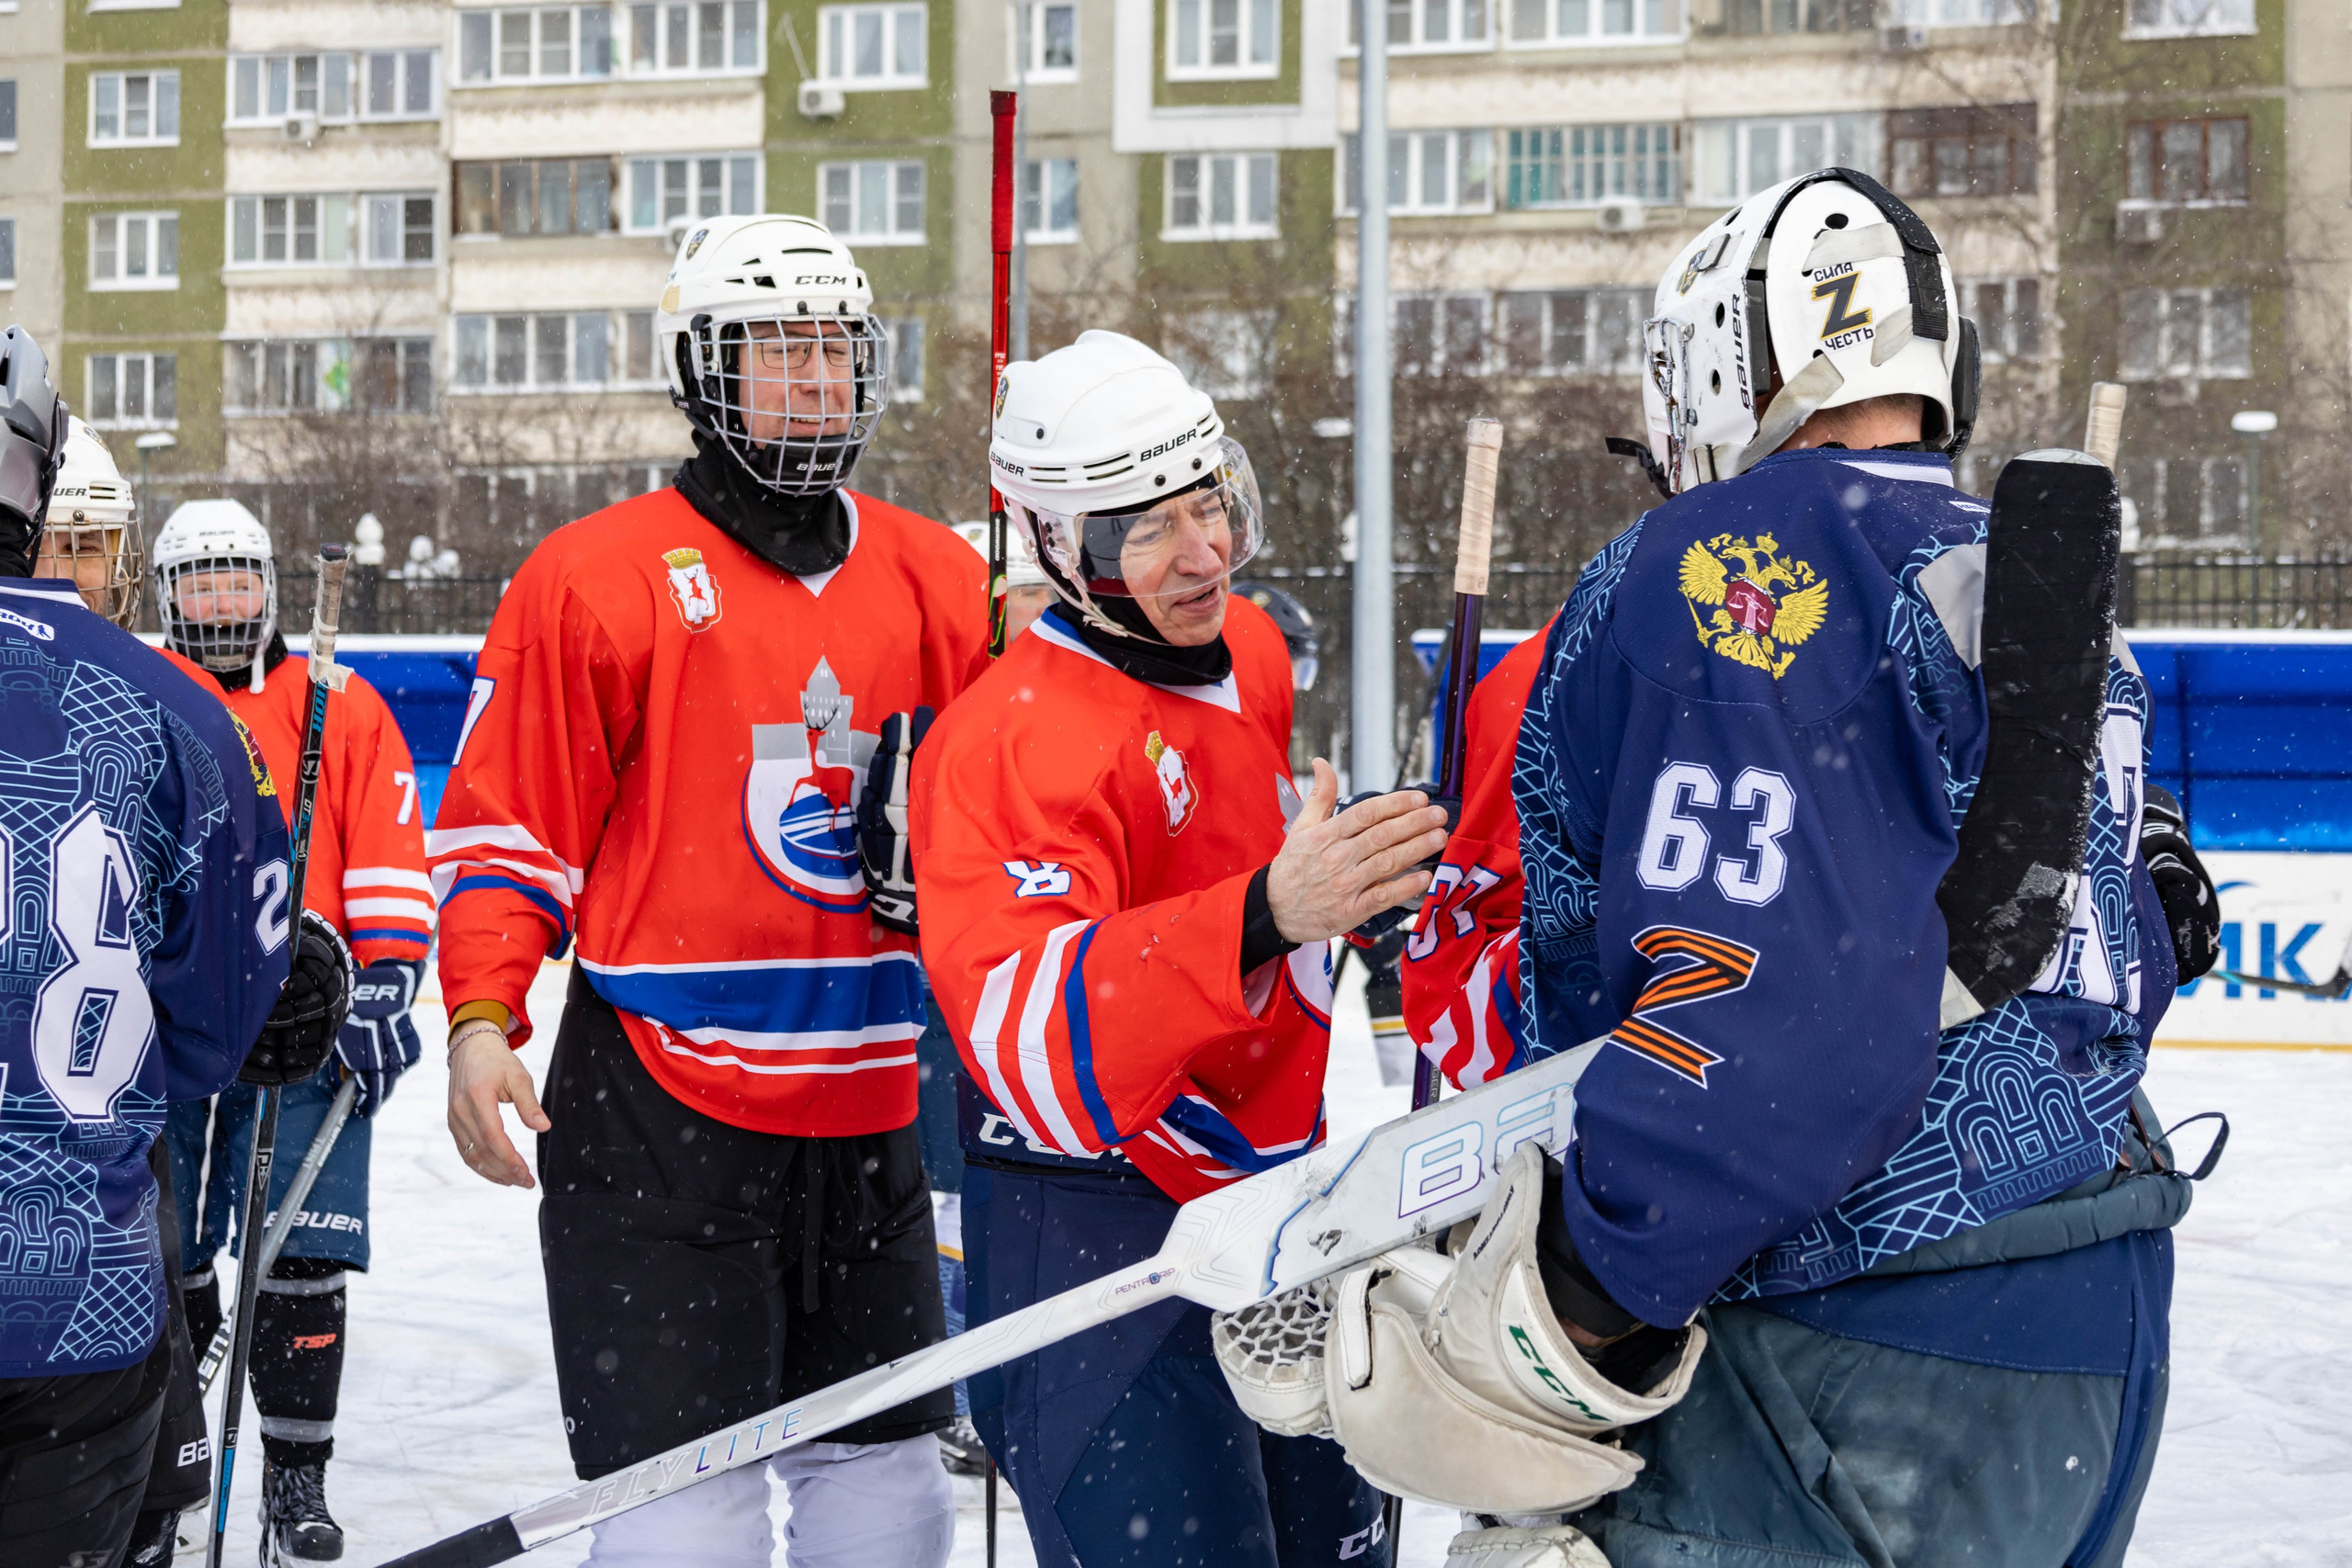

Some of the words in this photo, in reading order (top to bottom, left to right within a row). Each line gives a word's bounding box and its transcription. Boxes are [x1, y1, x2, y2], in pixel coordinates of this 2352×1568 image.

[795, 276, 848, 286] CCM
[1814, 262, 1854, 282] СИЛА
[1812, 271, 1873, 341] Z
[1731, 292, 1753, 411] BAUER
[1825, 327, 1875, 352] ЧЕСТЬ
[989, 450, 1024, 478] BAUER
[1140, 428, 1198, 463] BAUER
[52, 488, 87, 497] UER
[394, 771, 416, 826] 7
[1635, 761, 1797, 908] 63
[253, 857, 289, 956] 2
[0, 800, 156, 1124] 8
[301, 908, 356, 1014] Reebok
[354, 984, 401, 1001] ER
[1398, 1081, 1577, 1219] BA
[1510, 1325, 1613, 1423] CCM
[176, 1436, 211, 1468] BA
[1338, 1502, 1385, 1561] CC
